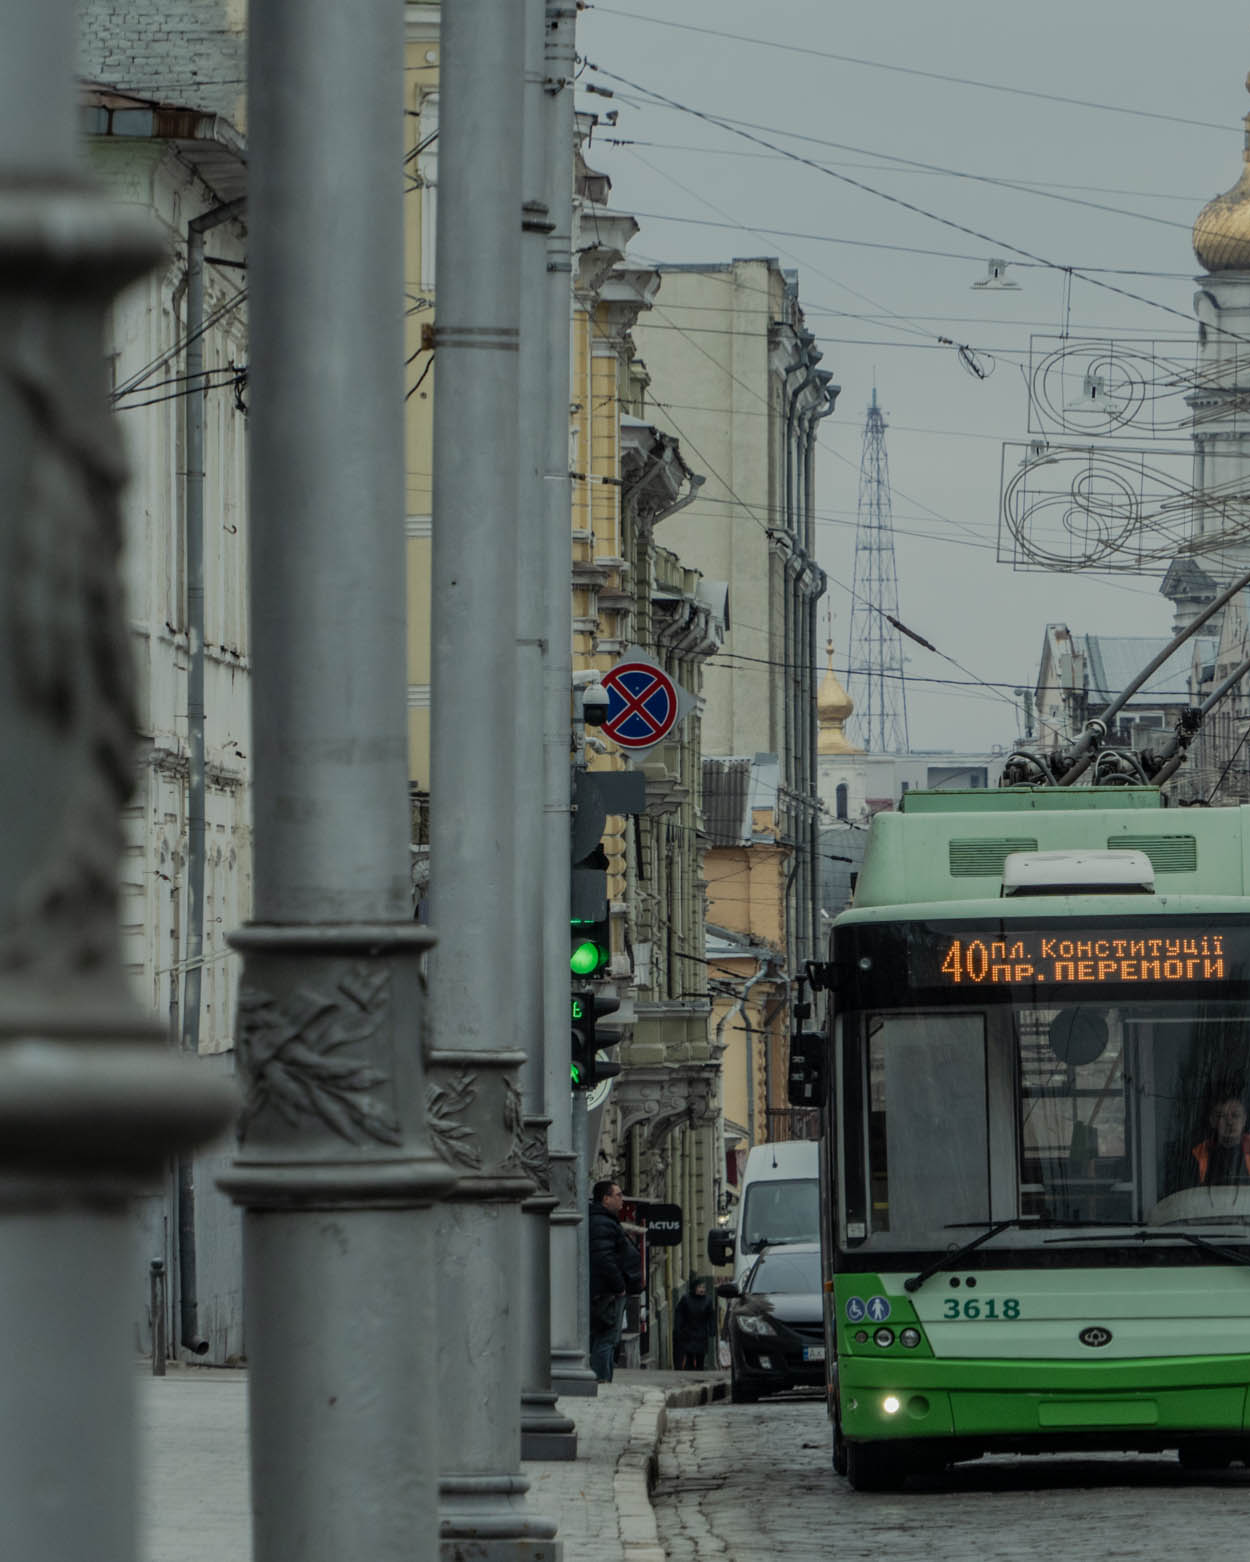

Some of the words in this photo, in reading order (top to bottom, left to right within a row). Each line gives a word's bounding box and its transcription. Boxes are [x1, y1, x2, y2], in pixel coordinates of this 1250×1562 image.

[941, 940, 989, 982] 40
[1055, 959, 1224, 981] ПЕРЕМОГИ
[648, 1221, 681, 1231] ACTUS
[943, 1298, 1021, 1320] 3618
